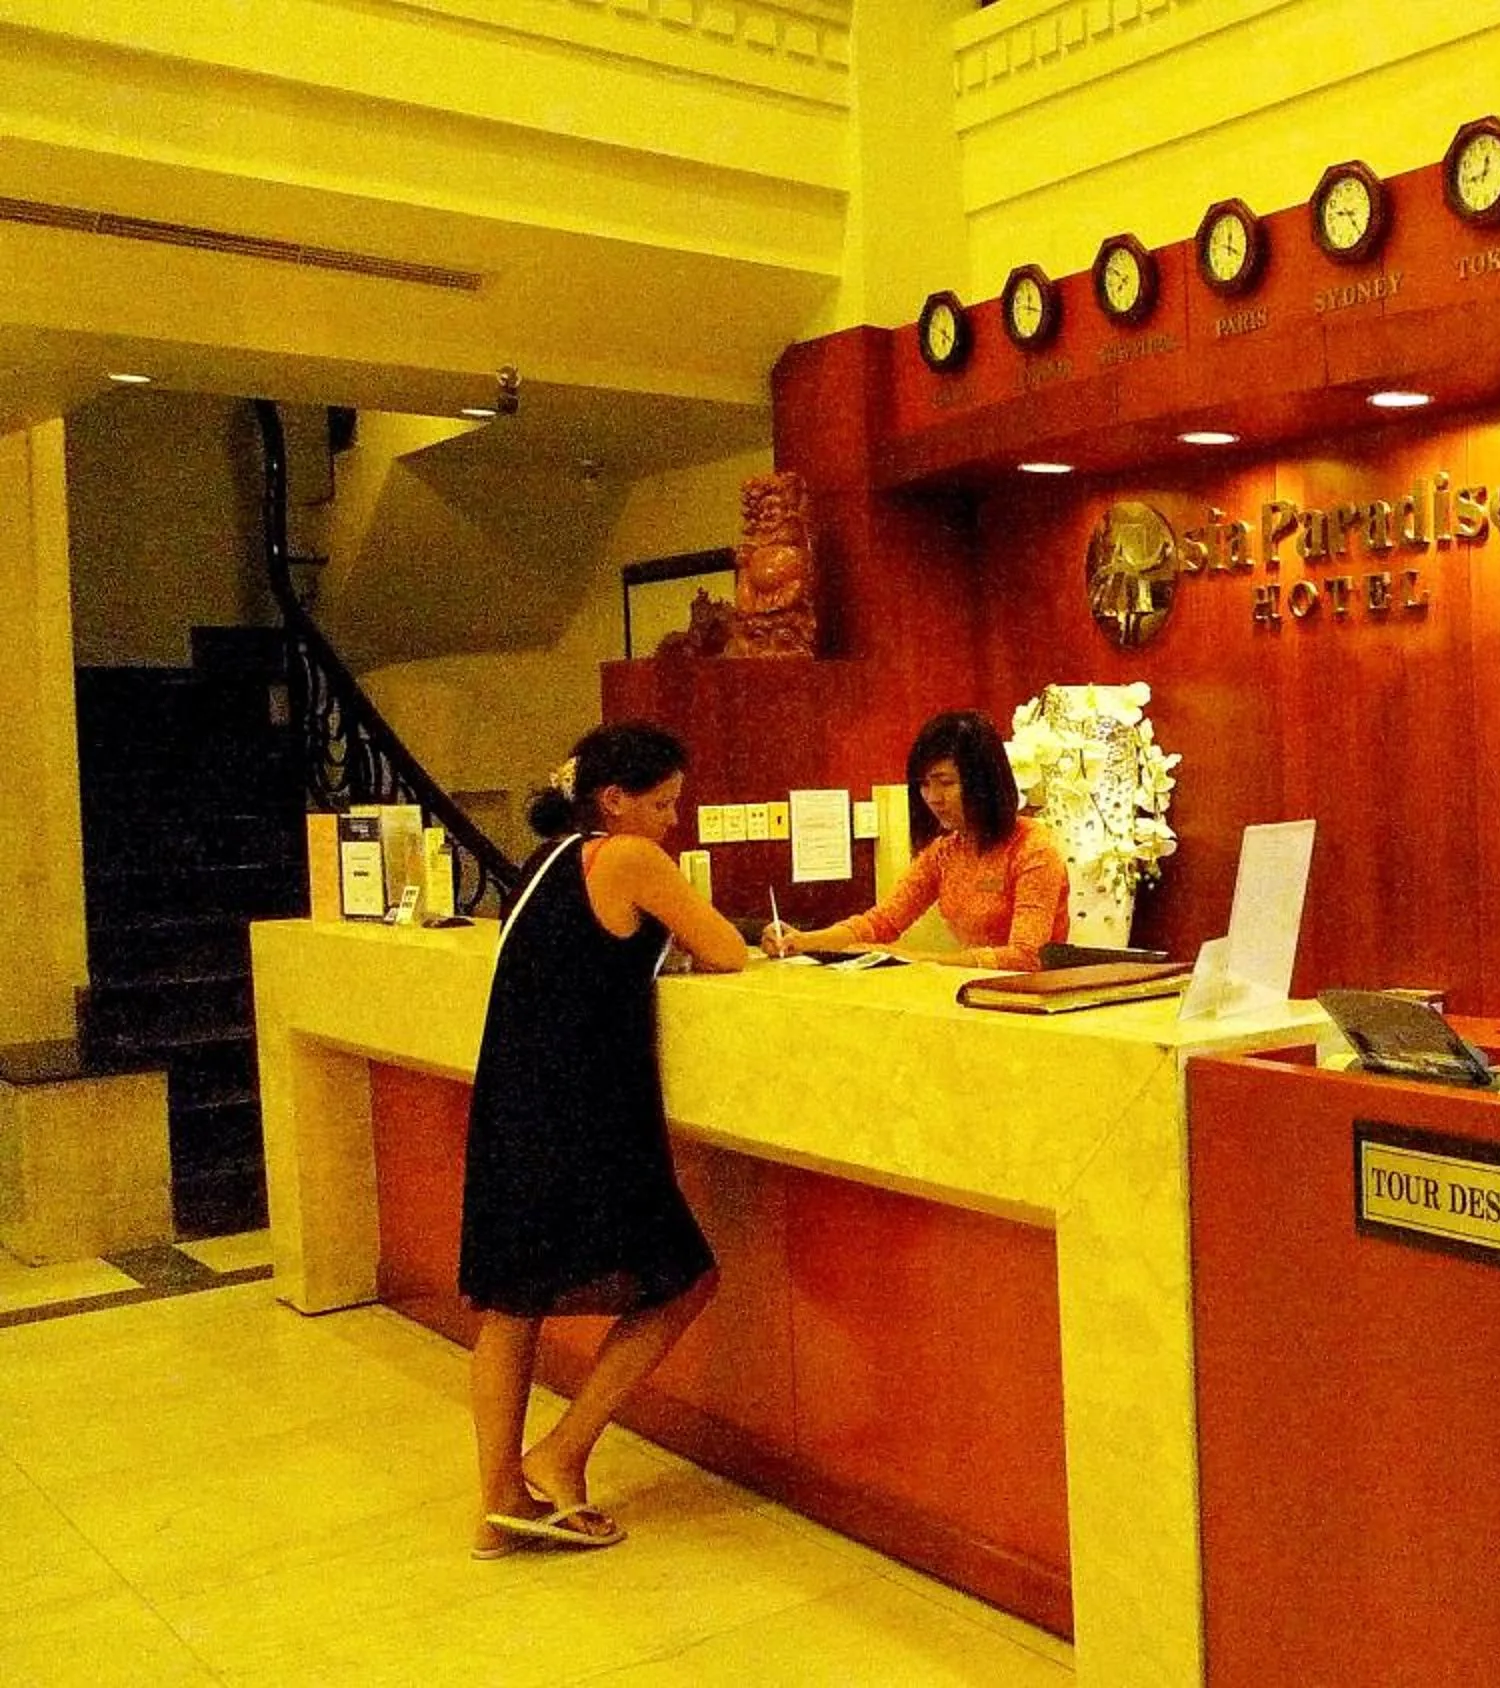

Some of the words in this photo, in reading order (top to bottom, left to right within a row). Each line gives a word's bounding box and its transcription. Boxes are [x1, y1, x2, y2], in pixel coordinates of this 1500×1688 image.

[1314, 272, 1404, 313] SYDNEY
[1253, 570, 1431, 622] HOTEL
[1371, 1167, 1441, 1210] TOUR
